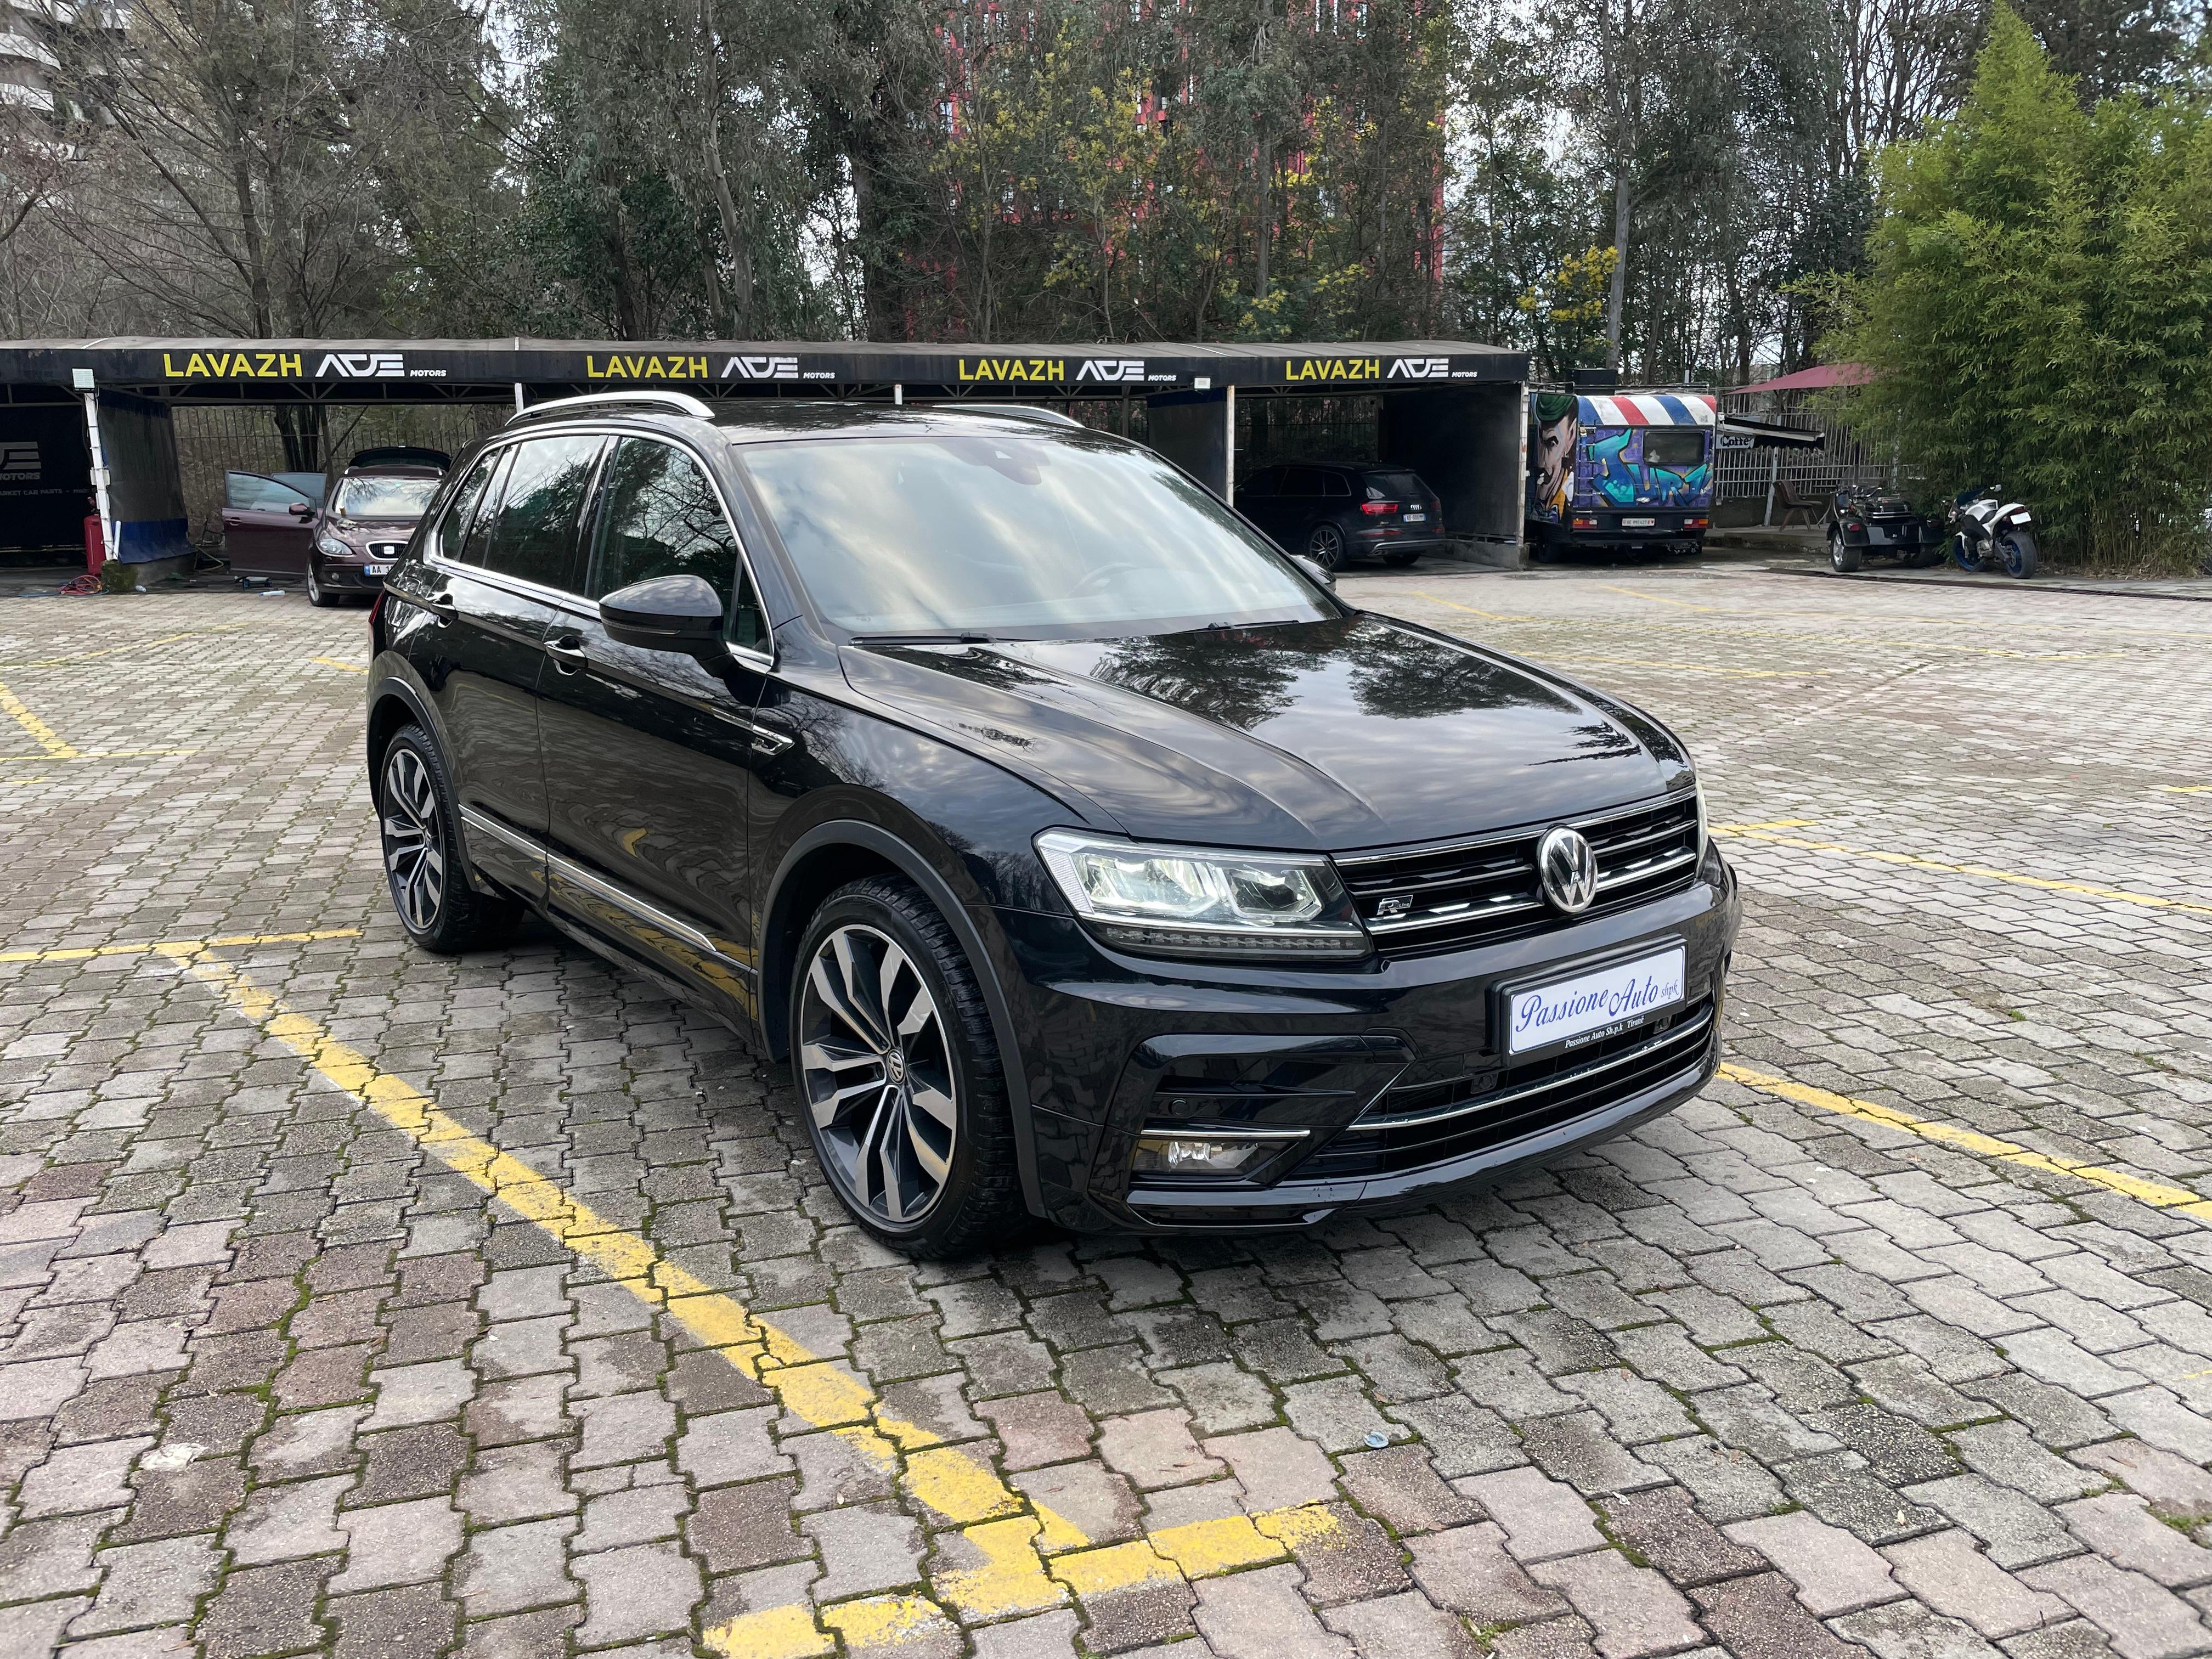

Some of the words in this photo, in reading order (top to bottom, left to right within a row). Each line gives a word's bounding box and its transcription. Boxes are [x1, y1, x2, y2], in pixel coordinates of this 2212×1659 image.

[163, 353, 302, 377] LAVAZH
[587, 356, 708, 379] LAVAZH
[959, 360, 1064, 381] LAVAZH
[1286, 360, 1380, 380] LAVAZH
[1516, 989, 1609, 1032] Passione
[1609, 975, 1658, 1017] Auto
[1661, 979, 1679, 999] shpk
[1565, 1036, 1590, 1048] Passione
[1591, 1031, 1605, 1041] Auto
